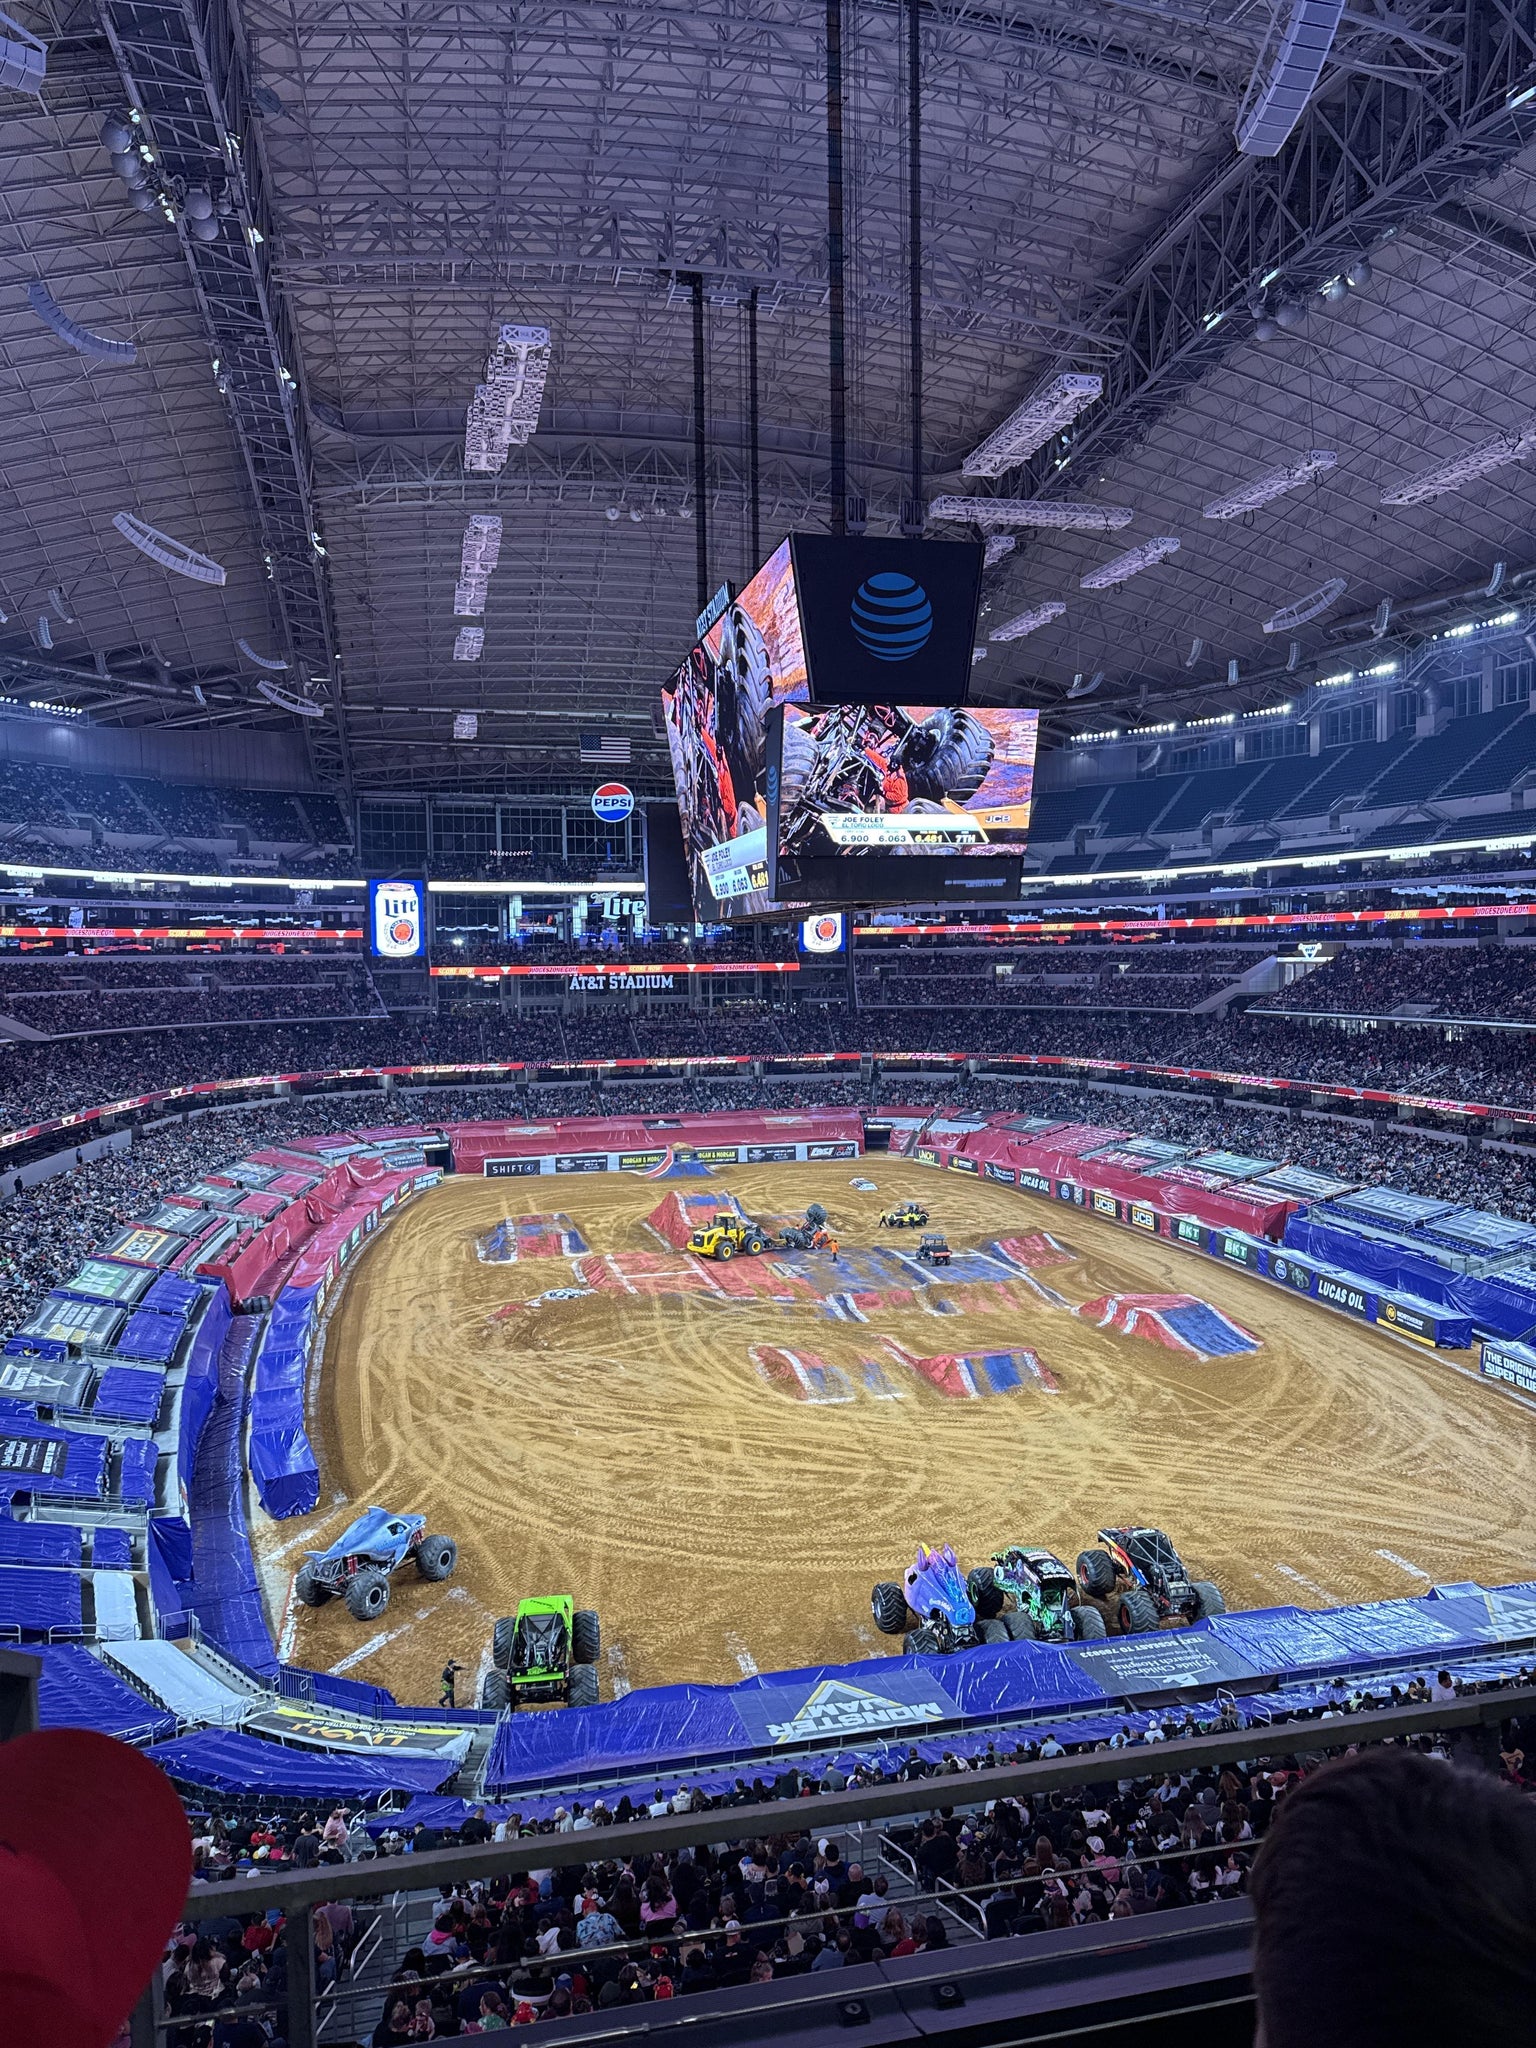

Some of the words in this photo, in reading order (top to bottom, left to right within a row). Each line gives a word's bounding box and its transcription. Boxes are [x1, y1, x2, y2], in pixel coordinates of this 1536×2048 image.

[595, 799, 631, 807] PEPSI
[985, 815, 1011, 823] JCB
[955, 834, 976, 844] 7TH
[384, 899, 417, 918] Lite
[601, 896, 647, 919] Lite
[1473, 906, 1530, 915] JUDGESZONE.COM
[569, 974, 606, 990] AT&T
[609, 974, 674, 990] STADIUM
[716, 1151, 736, 1159] MORGAN
[918, 1149, 935, 1162] UNOH
[492, 1164, 523, 1174] SHIFT
[1020, 1175, 1039, 1190] LUCAS
[1039, 1179, 1050, 1193] OIL
[1095, 1196, 1115, 1214] JCB
[1133, 1209, 1153, 1228] JCB
[1178, 1222, 1199, 1239] BKT
[1224, 1238, 1247, 1259] BKT
[1318, 1280, 1348, 1303] LUCAS
[1486, 1350, 1503, 1366] THE
[1485, 1361, 1516, 1383] SUPER
[1515, 1374, 1536, 1393] GLUE
[1182, 1636, 1206, 1645] TEXT
[1119, 1645, 1135, 1653] TO
[1110, 1657, 1163, 1671] Hospital
[1163, 1652, 1213, 1665] Research
[1178, 1660, 1206, 1670] Jude
[1117, 1663, 1176, 1677] Children's
[807, 1698, 889, 1719] JAM
[325, 1720, 372, 1731] NORTHWESTERN
[765, 1702, 944, 1738] MONSTER
[290, 1722, 409, 1746] UNOH
[380, 1726, 416, 1737] UNIVERSITY
